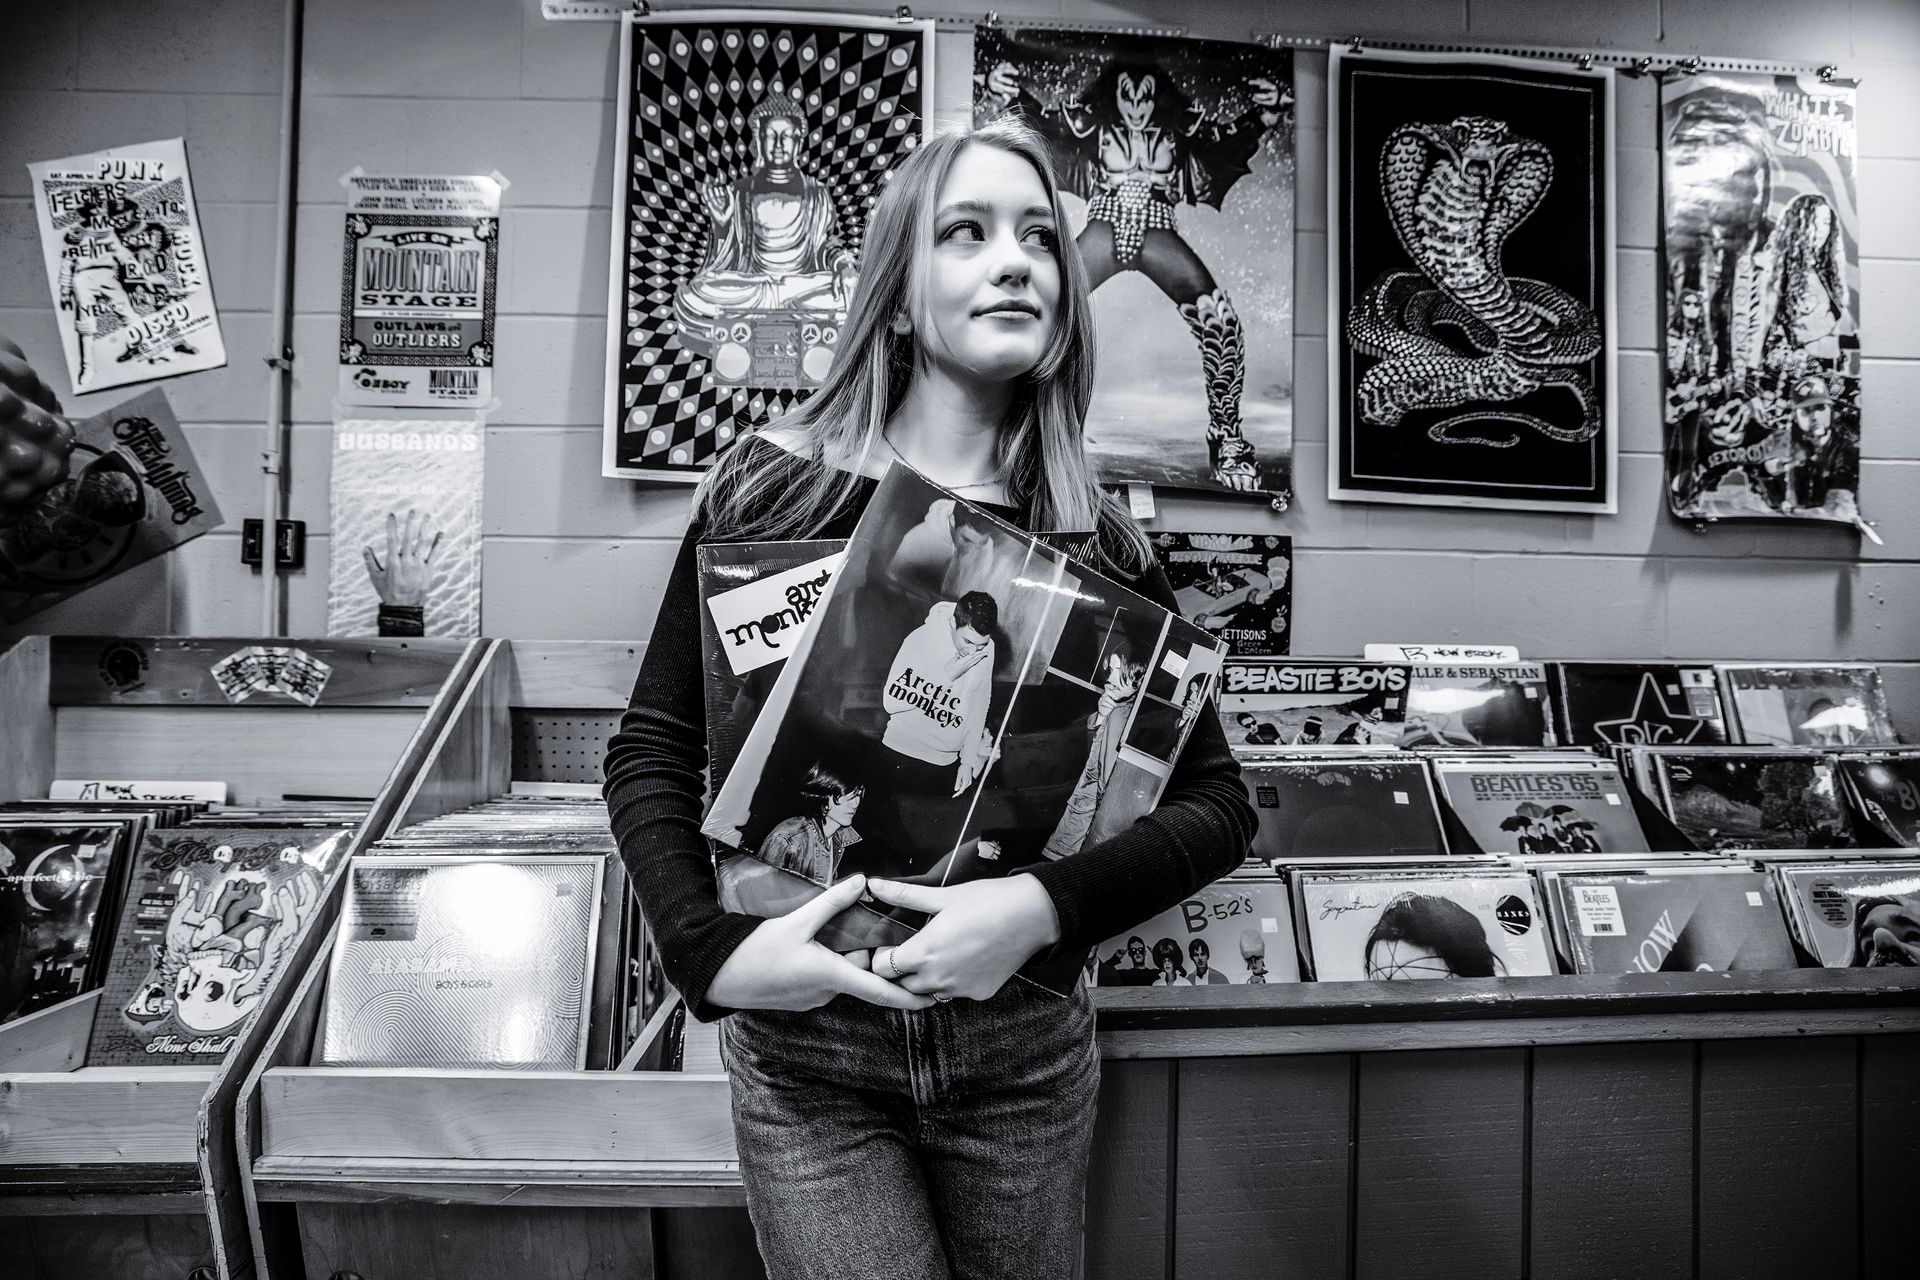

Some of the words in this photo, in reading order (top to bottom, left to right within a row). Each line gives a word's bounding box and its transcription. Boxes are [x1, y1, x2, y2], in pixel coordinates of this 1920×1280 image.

[1762, 90, 1846, 122] WHITE
[97, 160, 164, 181] PUNK
[396, 233, 427, 244] LIVE
[431, 234, 449, 245] ON
[362, 247, 480, 293] MOUNTAIN
[361, 294, 477, 307] STAGE
[127, 303, 190, 346] DISCO
[374, 321, 446, 331] OUTLAWS
[372, 333, 461, 348] OUTLIERS
[429, 370, 479, 388] MOUNTAIN
[338, 433, 479, 451] HUSBANDS
[725, 597, 820, 648] monk
[1218, 628, 1267, 641] JETTISONS
[1225, 666, 1336, 693] BEASTIE
[1338, 666, 1407, 693] BOYS
[1411, 667, 1444, 679] LLE
[1446, 667, 1458, 679] &
[1459, 667, 1541, 679] SEBASTIAN
[896, 667, 962, 711] Arctic
[888, 683, 964, 729] monkeys
[1470, 775, 1564, 793] BEATLES
[354, 880, 382, 889] BOYS
[367, 957, 472, 975] ALABAMA
[434, 979, 459, 990] BOYS
[145, 1034, 188, 1054] None
